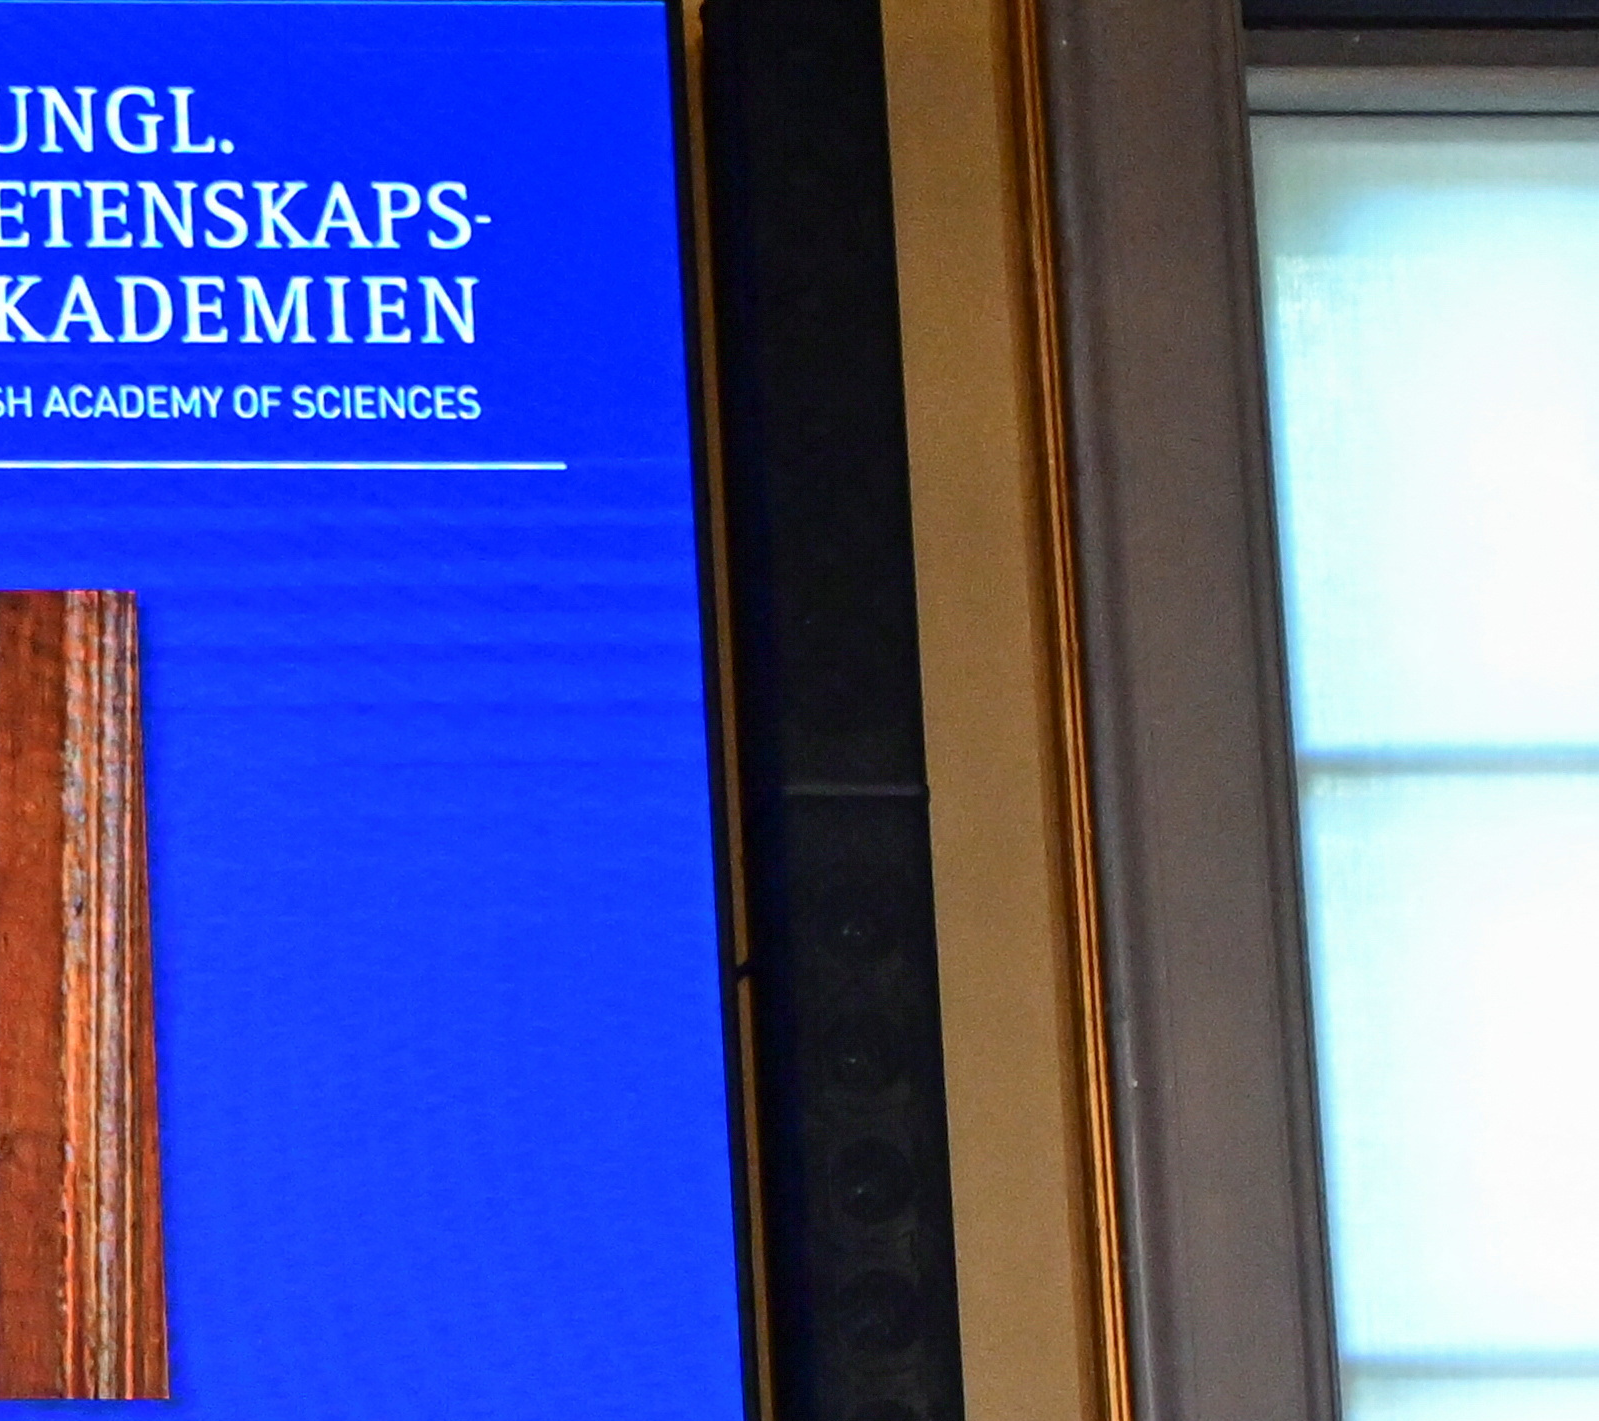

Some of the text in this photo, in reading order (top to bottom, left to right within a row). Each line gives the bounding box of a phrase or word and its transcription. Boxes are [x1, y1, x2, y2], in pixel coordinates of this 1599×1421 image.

[46, 386, 222, 417] ACADEMY
[236, 387, 279, 418] OF
[295, 387, 480, 419] SCIENCES
